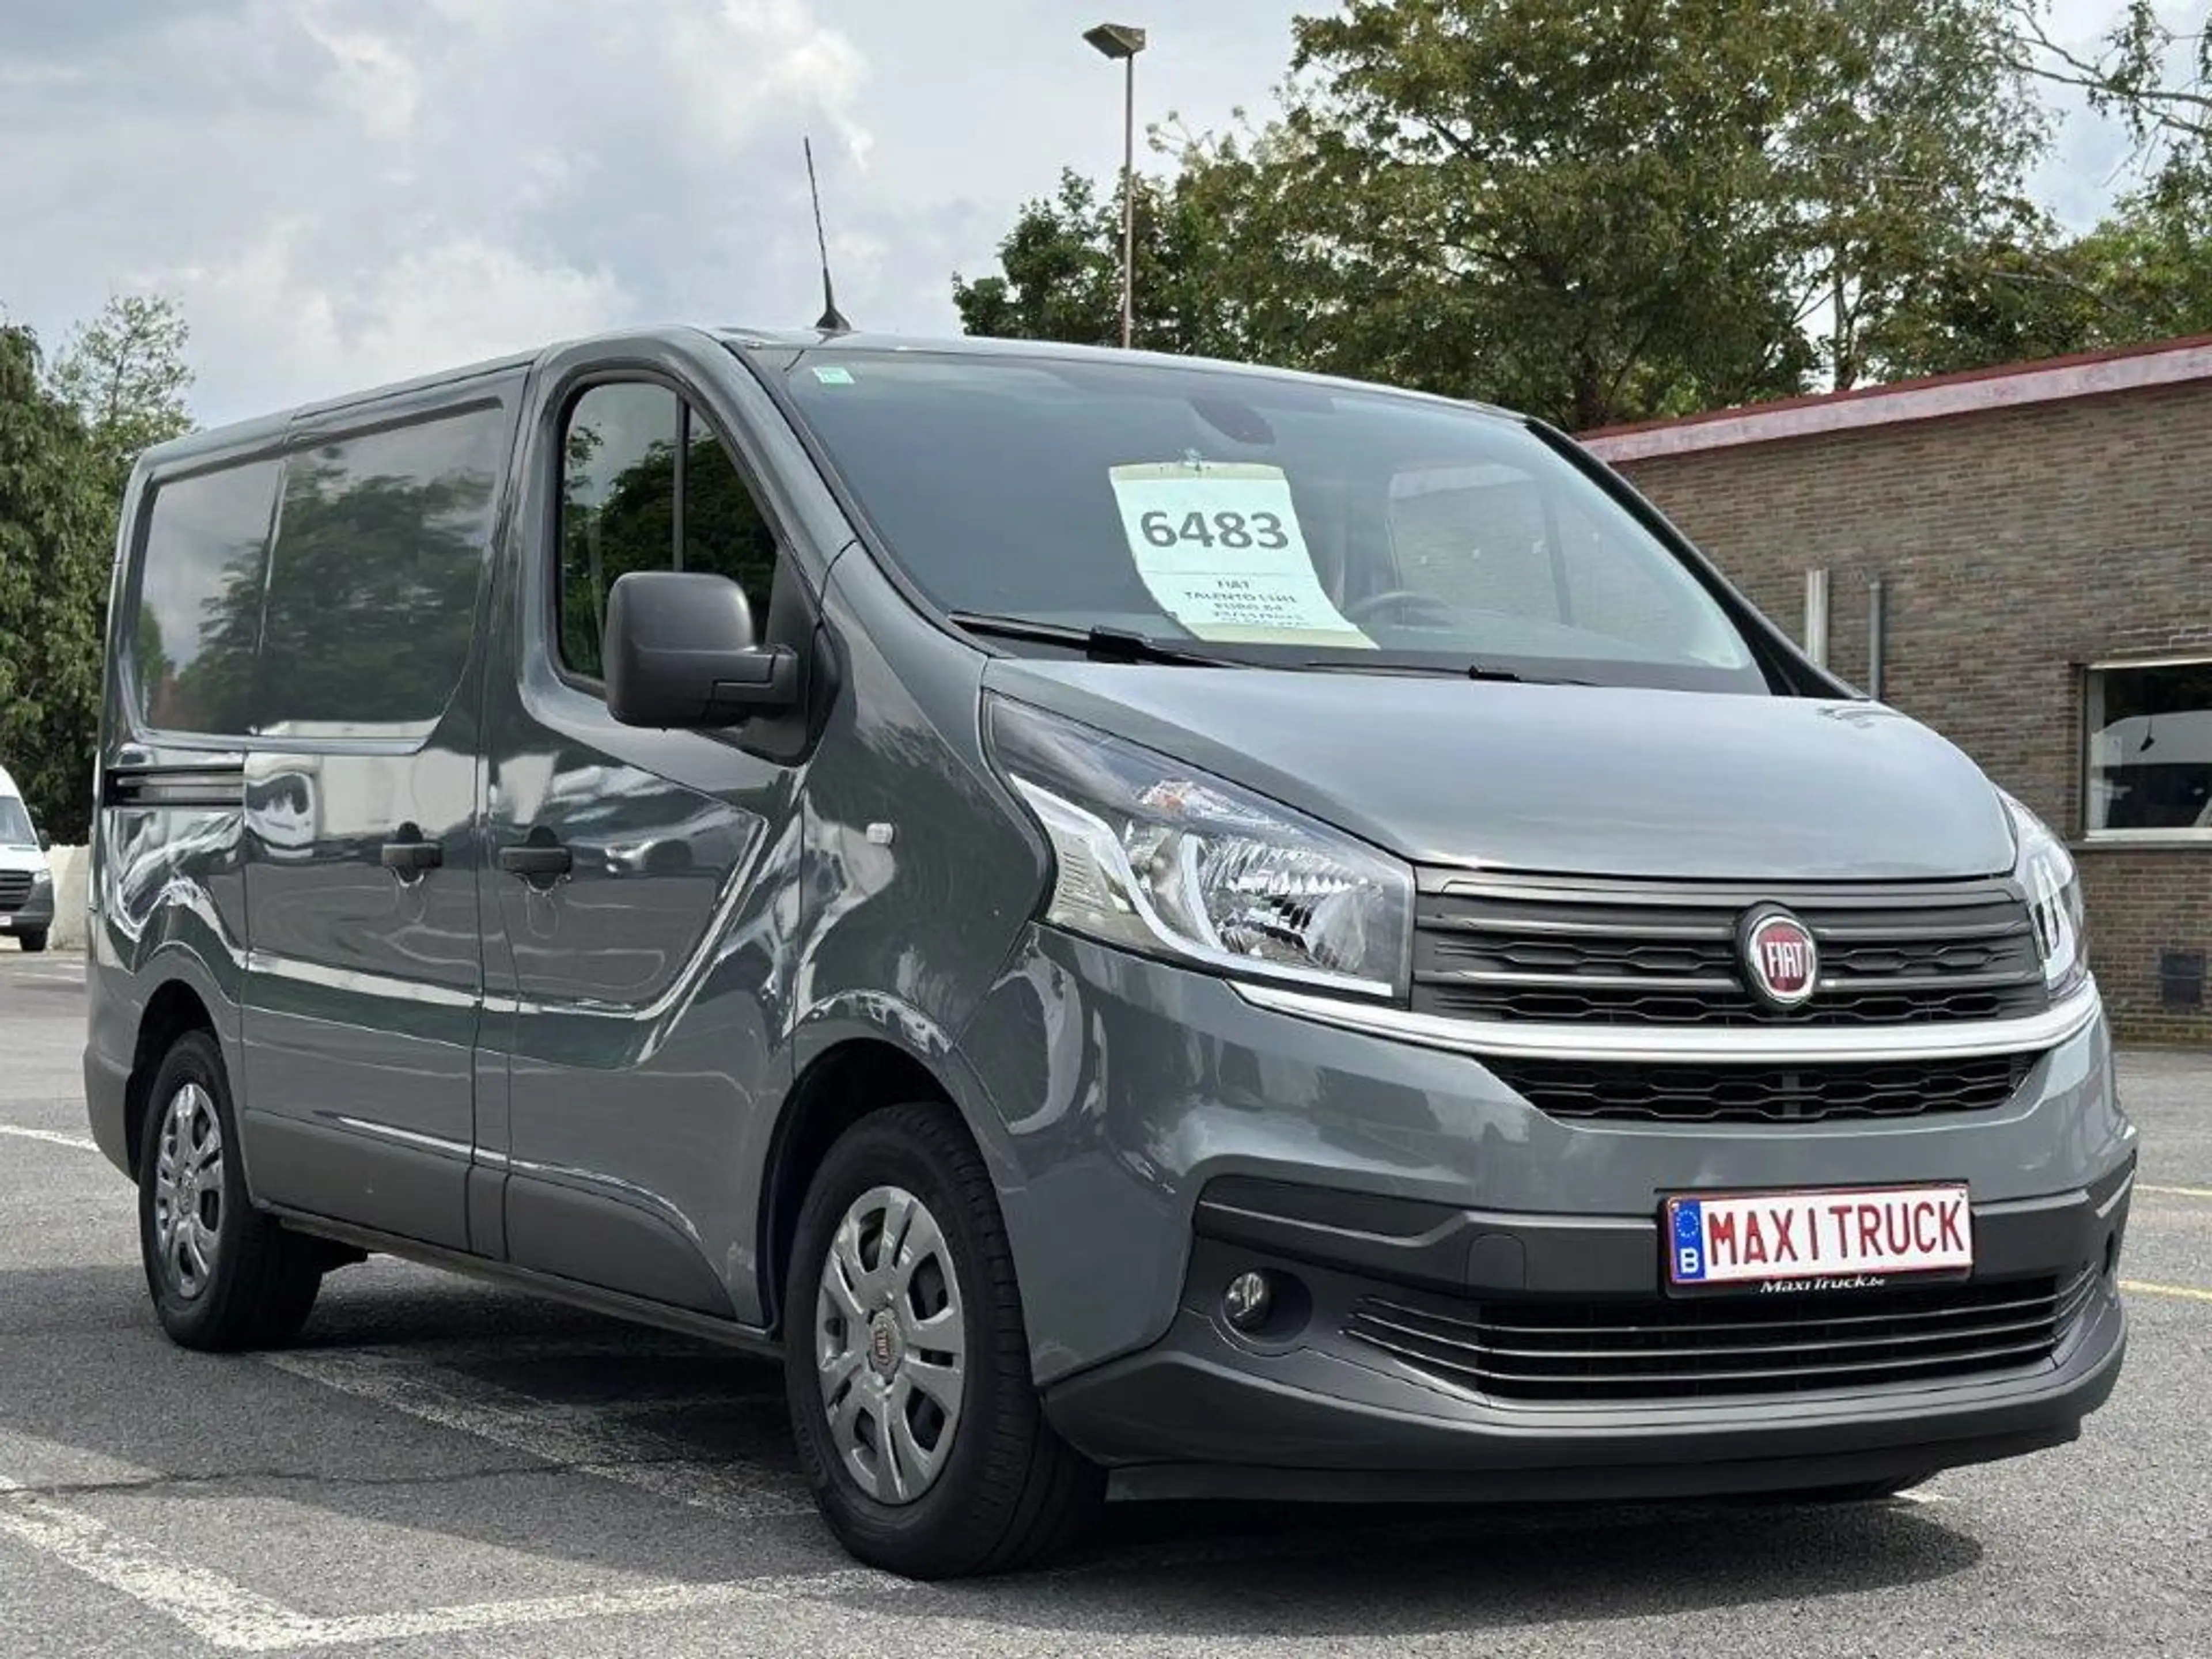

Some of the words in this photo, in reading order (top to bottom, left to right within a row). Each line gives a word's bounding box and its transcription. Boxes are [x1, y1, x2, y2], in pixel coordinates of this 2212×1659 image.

[1141, 511, 1289, 549] 6483
[1766, 941, 1802, 978] FIAT
[1680, 1248, 1699, 1274] B
